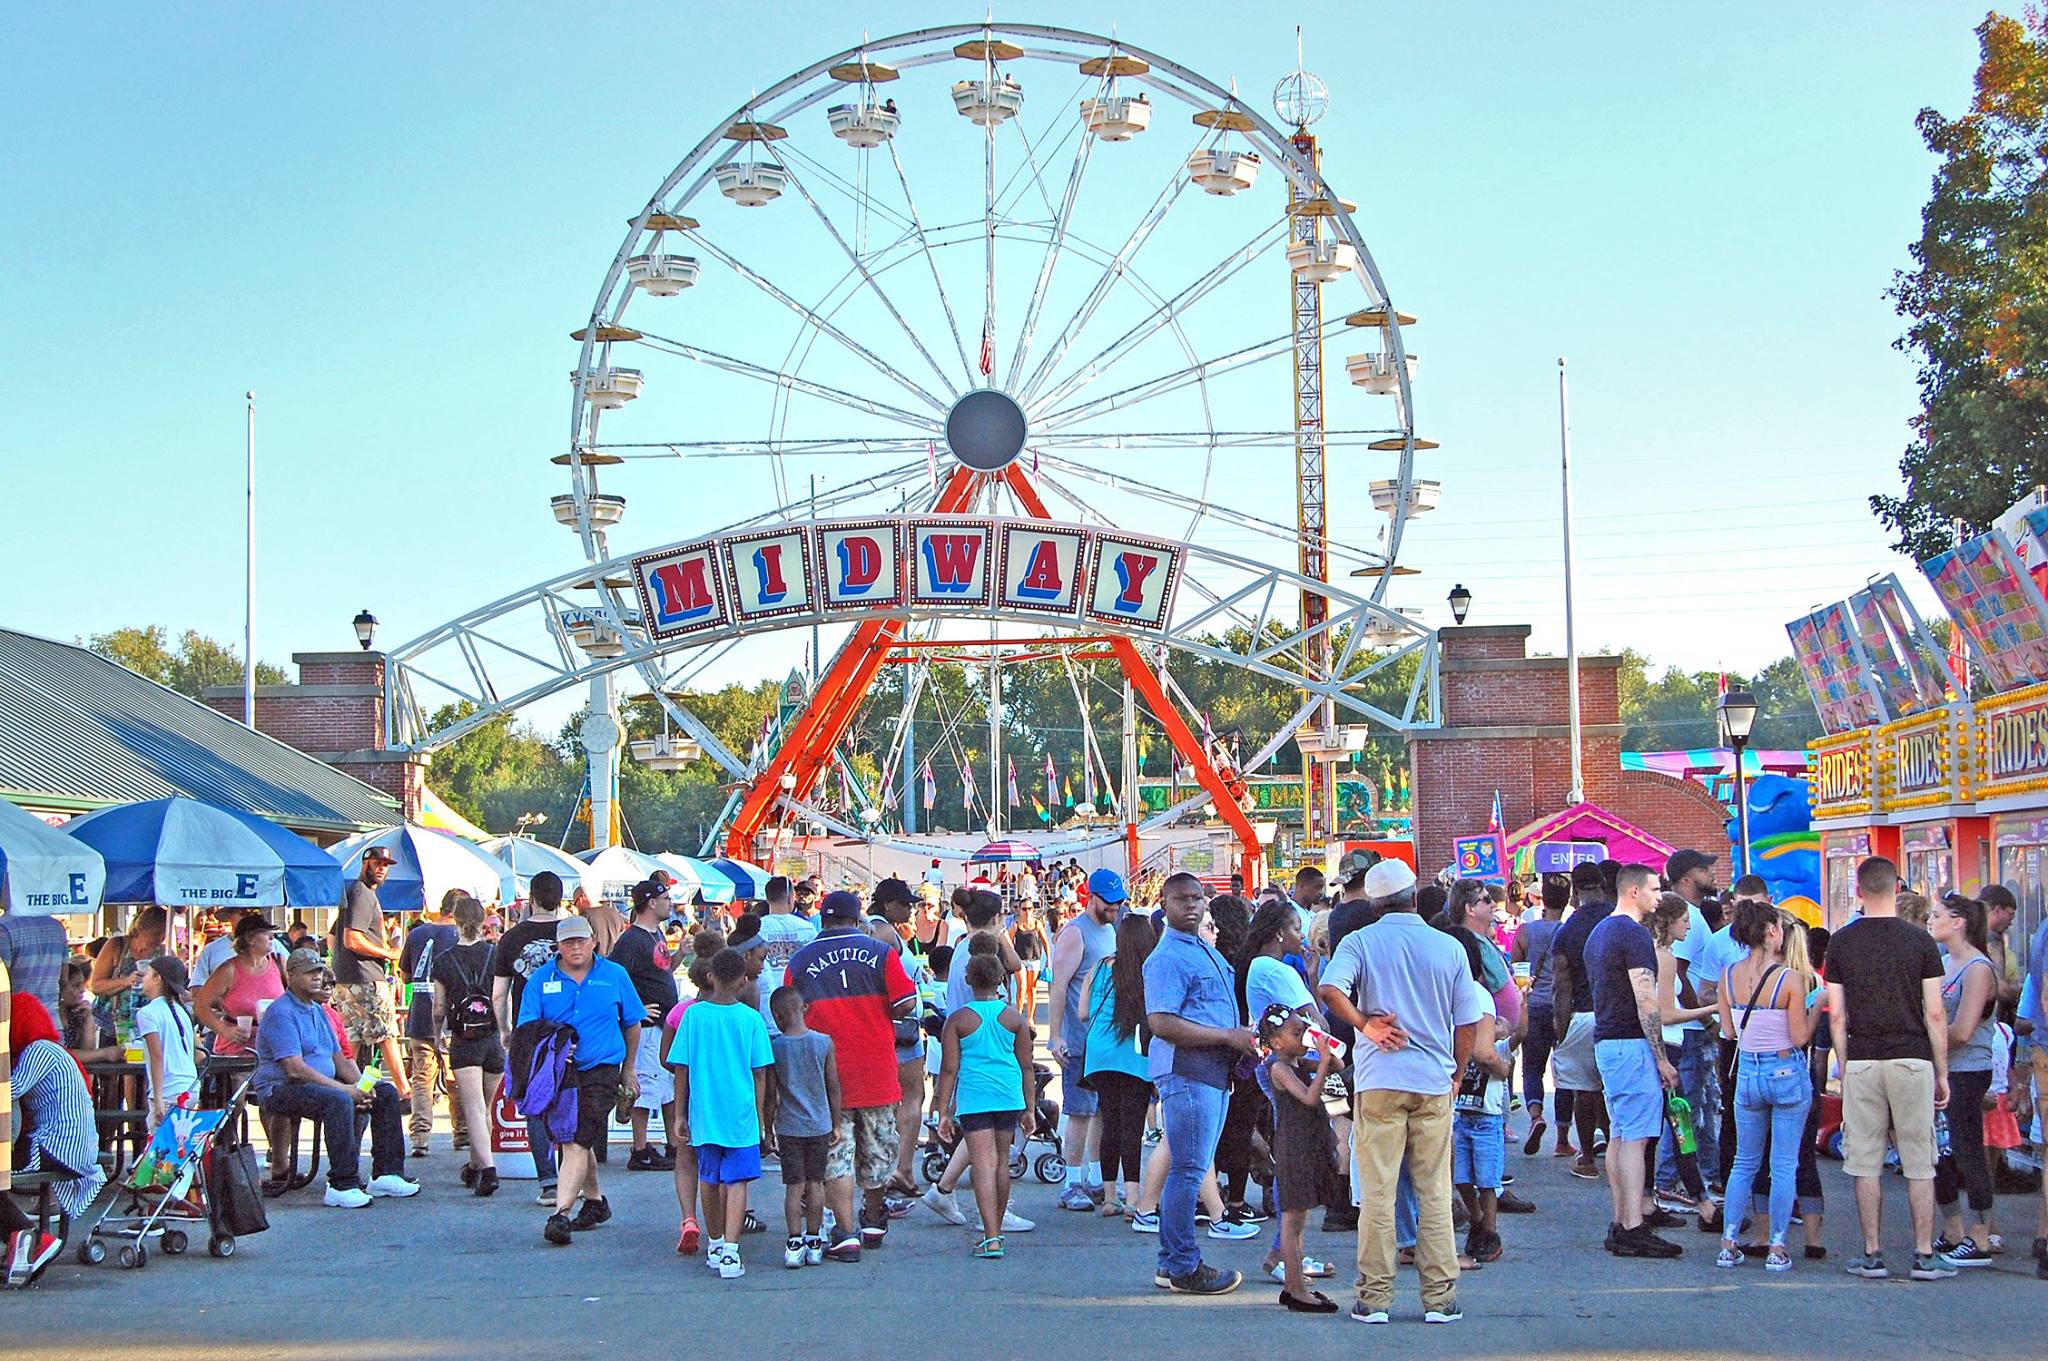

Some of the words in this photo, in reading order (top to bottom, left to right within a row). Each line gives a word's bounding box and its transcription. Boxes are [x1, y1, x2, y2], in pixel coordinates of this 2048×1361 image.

[649, 533, 1158, 626] MIDWAY
[1994, 708, 2048, 774] RIDES
[1822, 749, 1863, 800] RIDES
[1900, 731, 1942, 787] RIDES
[1466, 854, 1475, 866] 3
[26, 894, 50, 906] THE
[52, 893, 69, 906] BIG
[68, 873, 89, 905] E
[180, 888, 207, 899] THE
[210, 889, 233, 899] BIG
[234, 873, 260, 899] E
[806, 948, 879, 979] NAUTICA
[840, 969, 848, 989] 1
